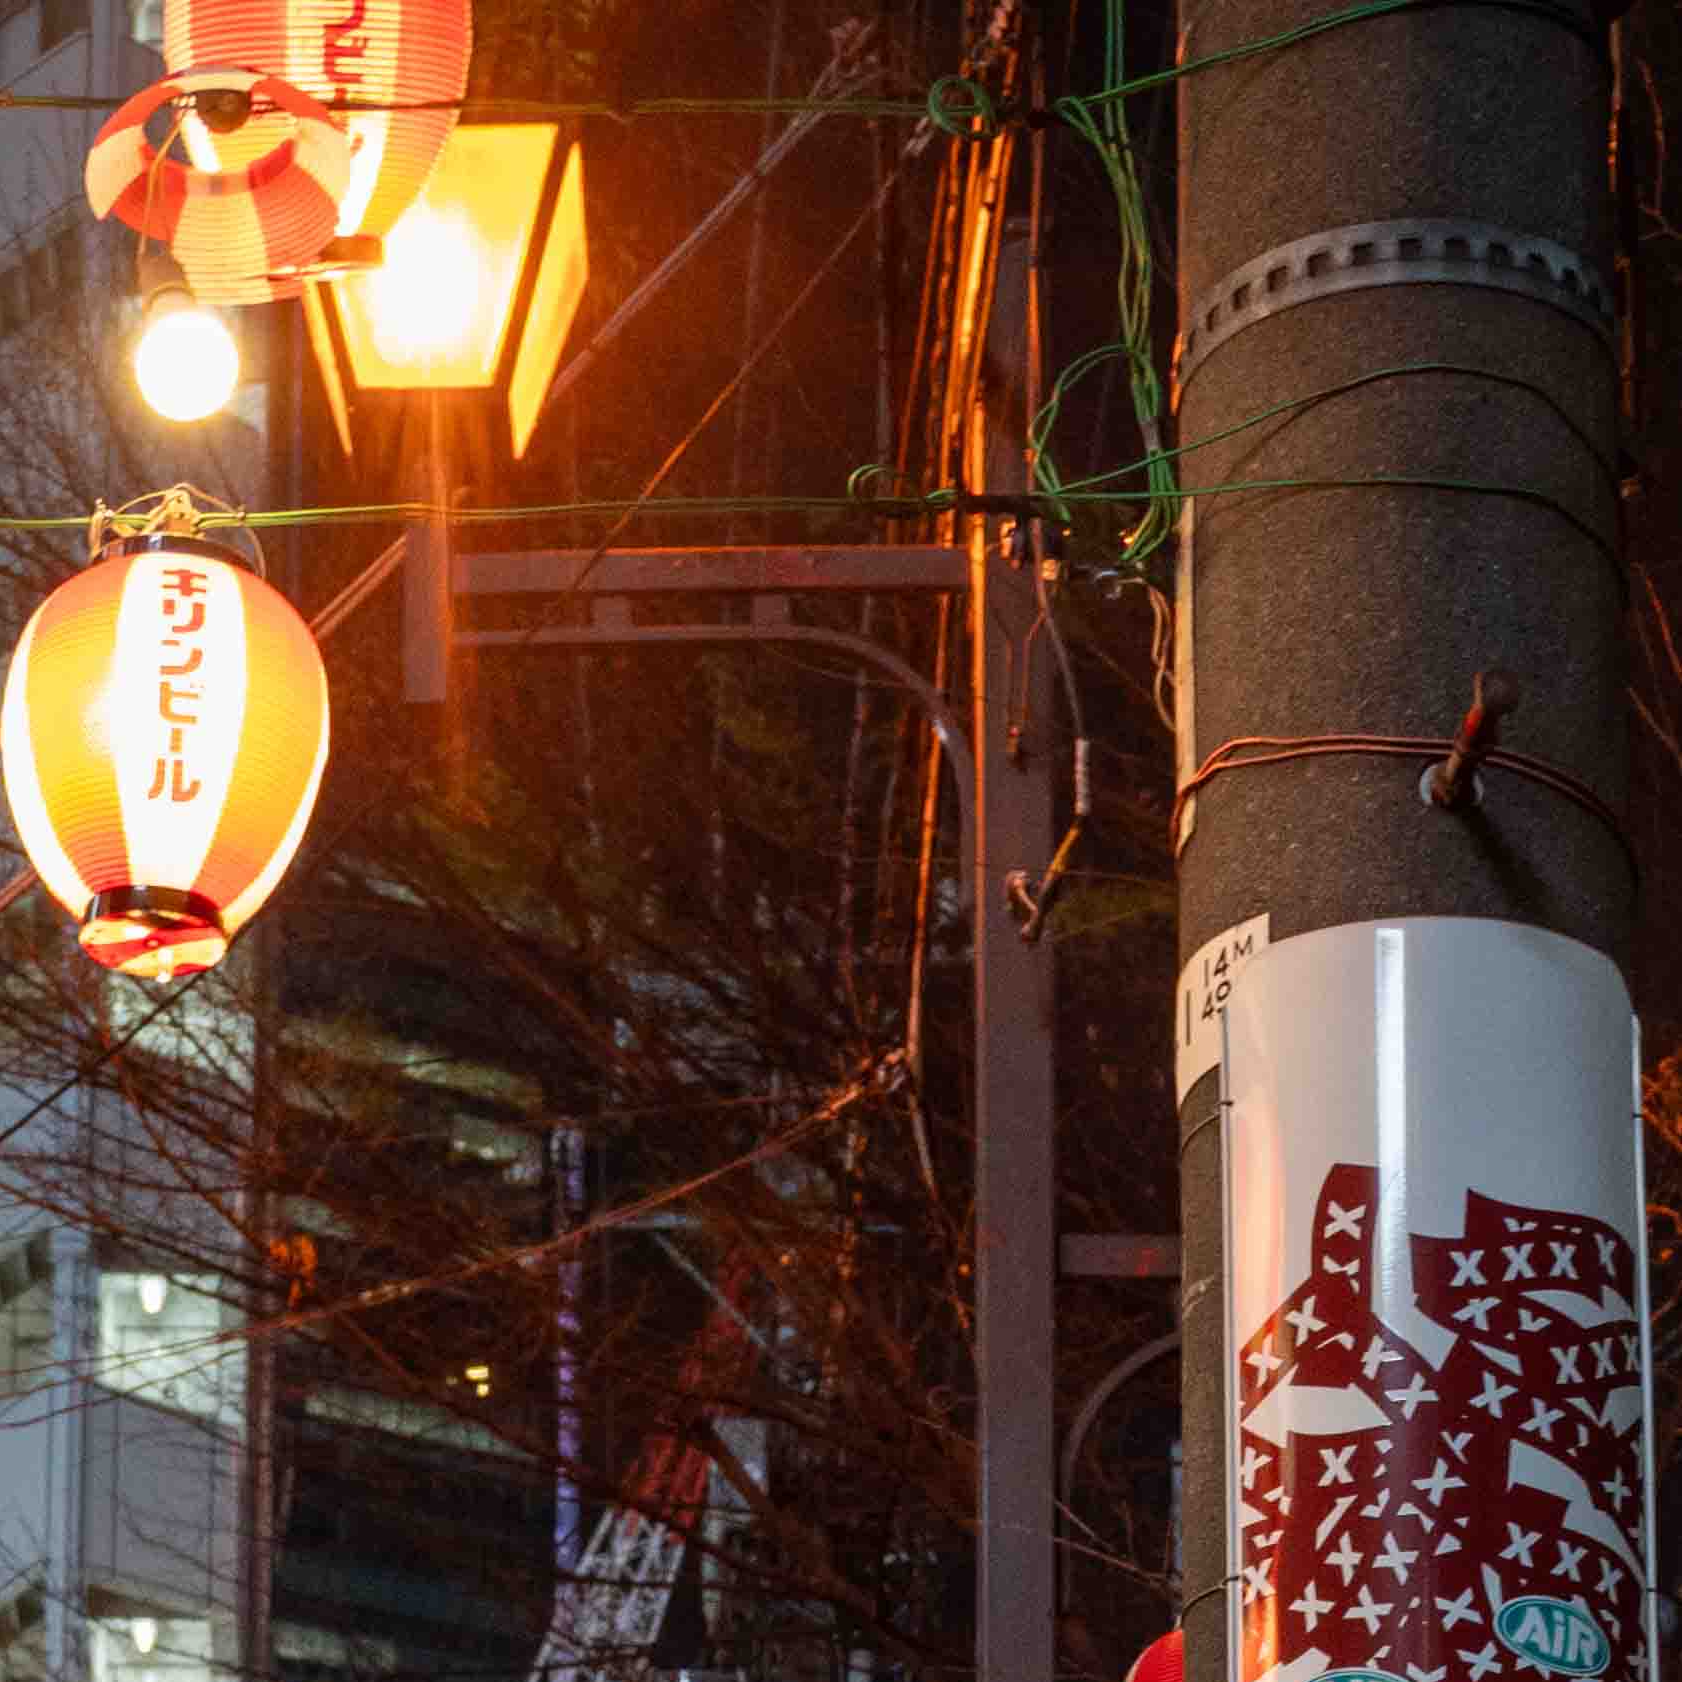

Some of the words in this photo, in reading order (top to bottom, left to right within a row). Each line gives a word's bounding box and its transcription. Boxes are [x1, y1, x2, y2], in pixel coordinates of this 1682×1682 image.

[147, 568, 209, 804] キリンビール
